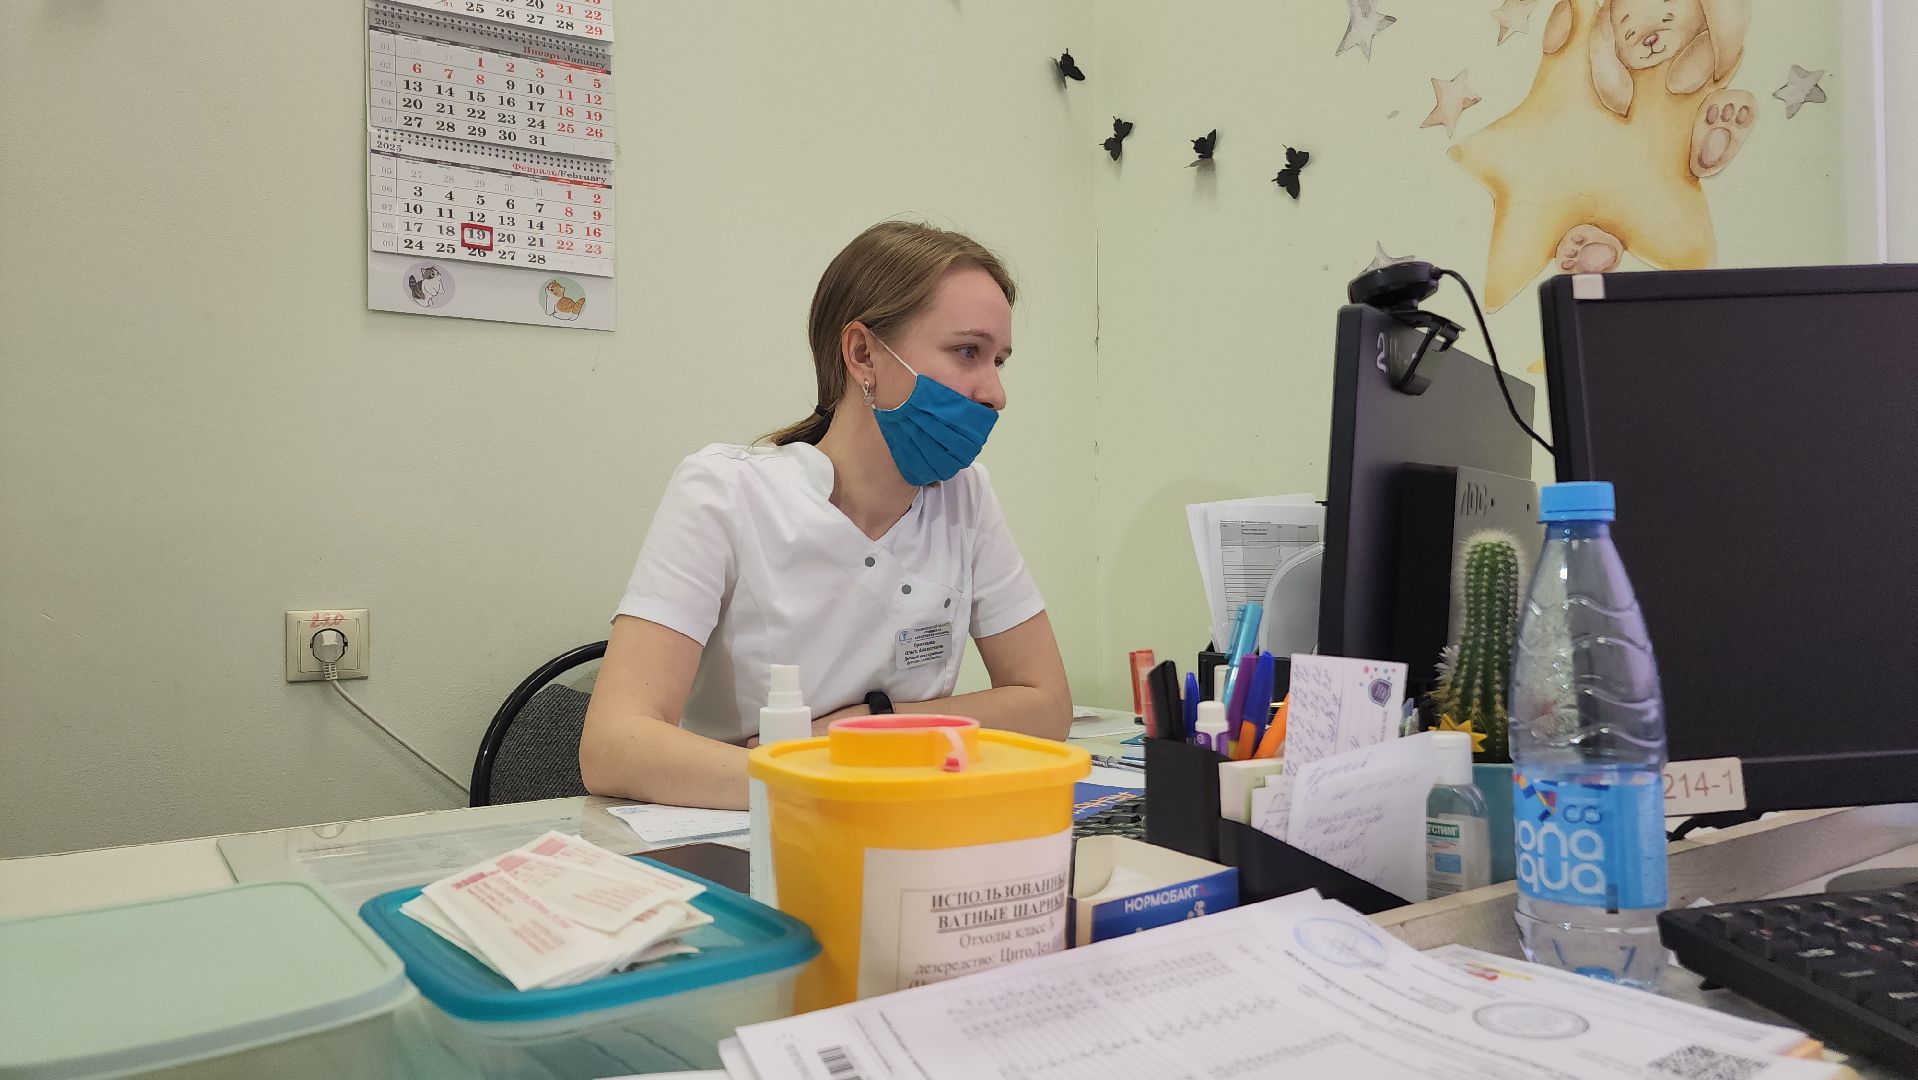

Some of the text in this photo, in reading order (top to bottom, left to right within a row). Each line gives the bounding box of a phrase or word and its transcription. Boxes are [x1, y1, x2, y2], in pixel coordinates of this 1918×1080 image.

[375, 18, 401, 29] 2025
[465, 2, 485, 14] 25
[496, 8, 515, 20] 26
[526, 13, 544, 25] 27
[556, 19, 574, 31] 28
[585, 25, 603, 36] 29
[526, 0, 544, 9] 20
[556, 3, 573, 15] 21
[584, 9, 602, 21] 22
[412, 63, 422, 74] 6
[444, 69, 453, 80] 7
[476, 74, 485, 85] 8
[506, 80, 515, 90] 9
[527, 83, 545, 96] 10
[559, 89, 573, 101] 11
[585, 93, 602, 105] 12
[478, 57, 484, 68] 1
[506, 62, 515, 73] 2
[536, 67, 544, 78] 3
[564, 73, 573, 84] 4
[593, 78, 602, 89] 5
[403, 80, 423, 92] 13
[435, 84, 455, 97] 14
[467, 90, 486, 103] 15
[498, 95, 516, 107] 16
[527, 101, 545, 113] 17
[559, 106, 574, 118] 18
[585, 110, 603, 122] 19
[402, 97, 423, 110] 20
[435, 102, 456, 115] 21
[466, 107, 486, 120] 22
[498, 112, 516, 125] 23
[526, 117, 546, 130] 24
[557, 122, 575, 134] 25
[585, 126, 603, 138] 26
[403, 115, 423, 128] 27
[435, 120, 456, 132] 28
[467, 125, 487, 137] 29
[498, 130, 517, 142] 30
[528, 134, 547, 146] 31
[376, 141, 402, 152] 2025
[413, 185, 423, 197] 3
[444, 190, 455, 201] 4
[476, 194, 485, 206] 5
[505, 199, 515, 209] 6
[535, 203, 544, 213] 7
[564, 207, 574, 217] 8
[592, 210, 602, 220] 9
[566, 190, 573, 200] 1
[593, 193, 601, 204] 2
[403, 202, 423, 214] 10
[436, 207, 456, 219] 11
[467, 211, 486, 223] 12
[498, 215, 516, 227] 13
[527, 219, 545, 231] 14
[557, 223, 574, 235] 15
[584, 226, 602, 238] 16
[403, 238, 424, 250] 24
[435, 242, 456, 254] 25
[467, 247, 487, 258] 26
[497, 249, 516, 261] 27
[527, 253, 547, 264] 28
[404, 221, 423, 233] 17
[437, 225, 455, 236] 18
[468, 229, 486, 240] 19
[497, 232, 516, 244] 20
[527, 235, 545, 247] 21
[556, 239, 574, 251] 22
[584, 243, 602, 255] 23
[1664, 769, 1734, 800] 214-1
[1516, 820, 1605, 861] ona
[1517, 852, 1606, 896] qua
[1124, 884, 1199, 914] НОРМОБАКТ
[938, 905, 1008, 929] ВАТНЫЕ
[958, 929, 1011, 949] Отходы
[1016, 925, 1046, 941] класс
